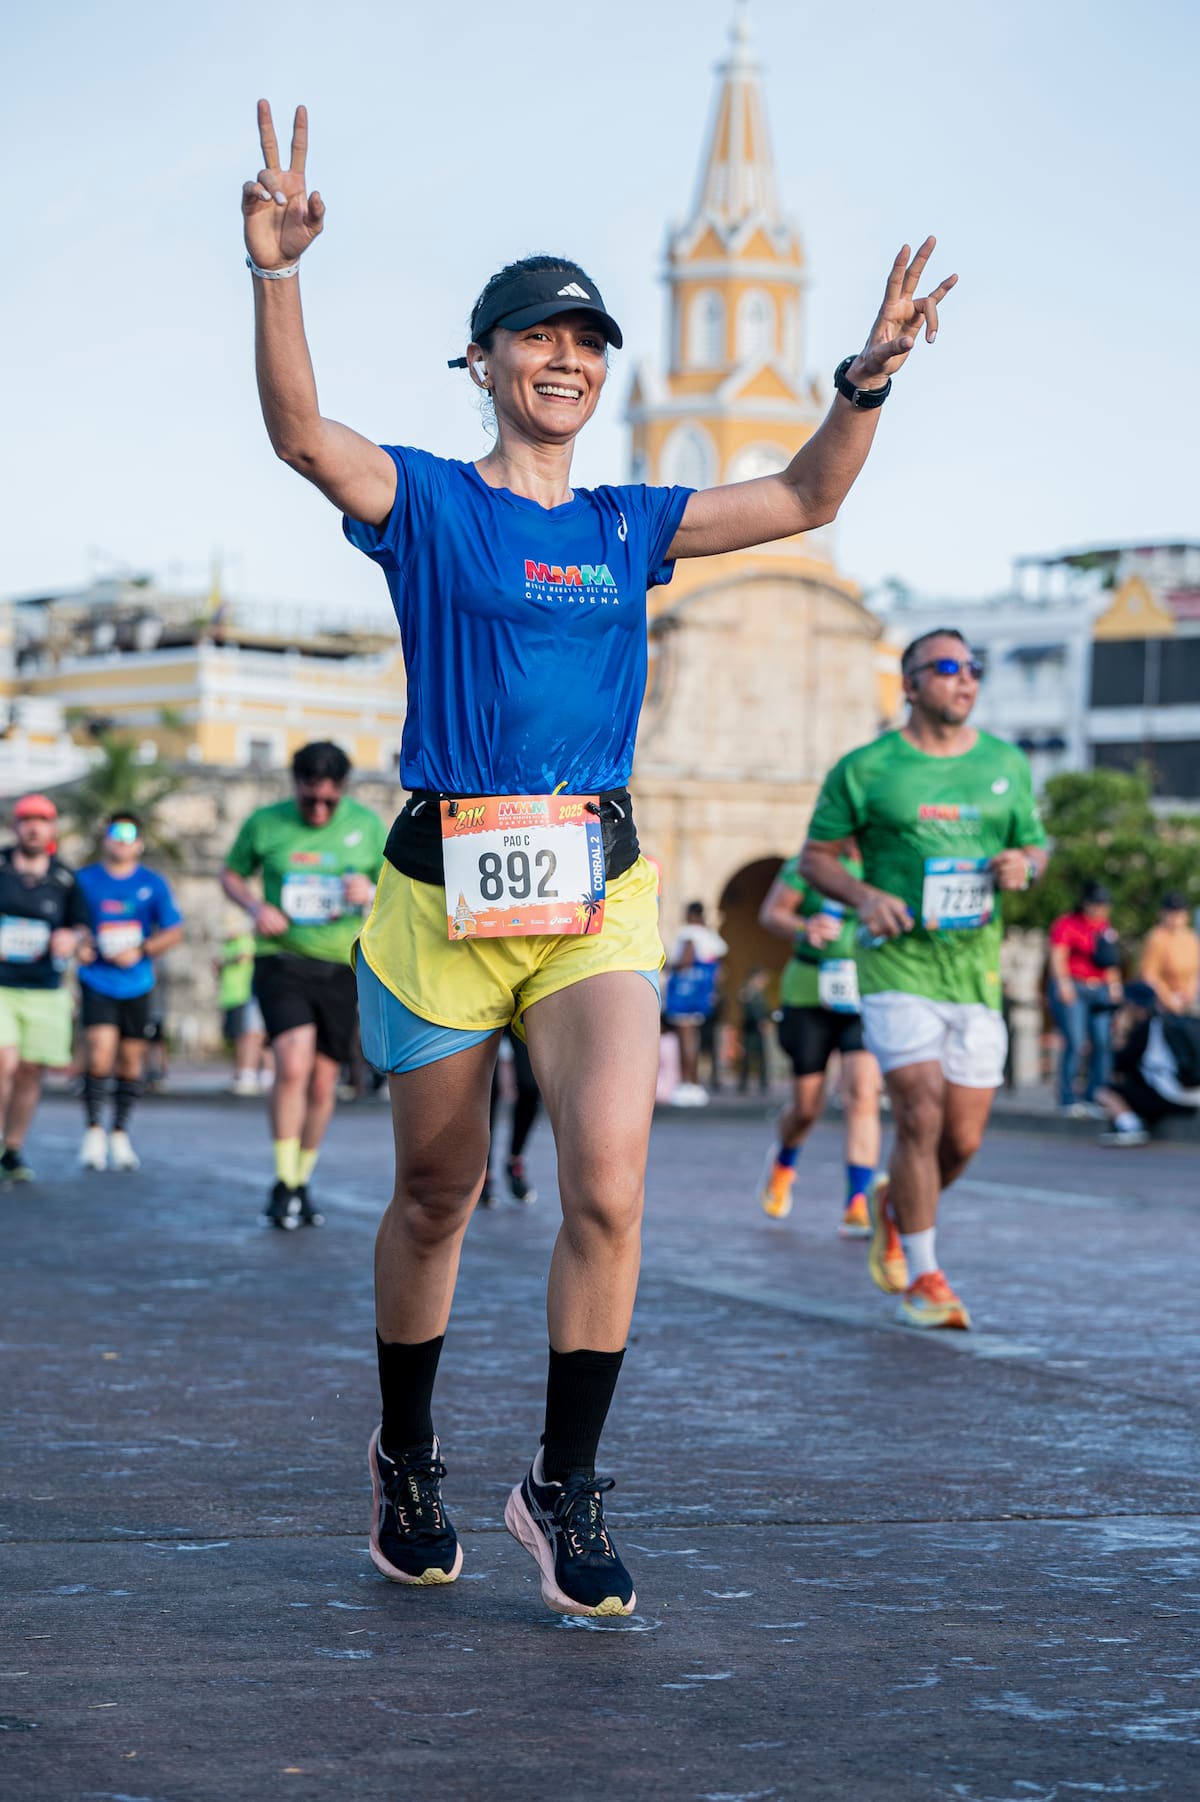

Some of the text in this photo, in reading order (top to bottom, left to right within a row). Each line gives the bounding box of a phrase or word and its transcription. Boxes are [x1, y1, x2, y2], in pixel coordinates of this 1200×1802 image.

[524, 559, 616, 586] MMM
[525, 592, 620, 605] CARTAGENA
[455, 805, 486, 832] 21K
[499, 801, 549, 816] MMM
[558, 803, 583, 820] 2025
[503, 835, 530, 847] PAO C
[590, 836, 603, 891] CORRAL 2
[478, 849, 559, 901] 892
